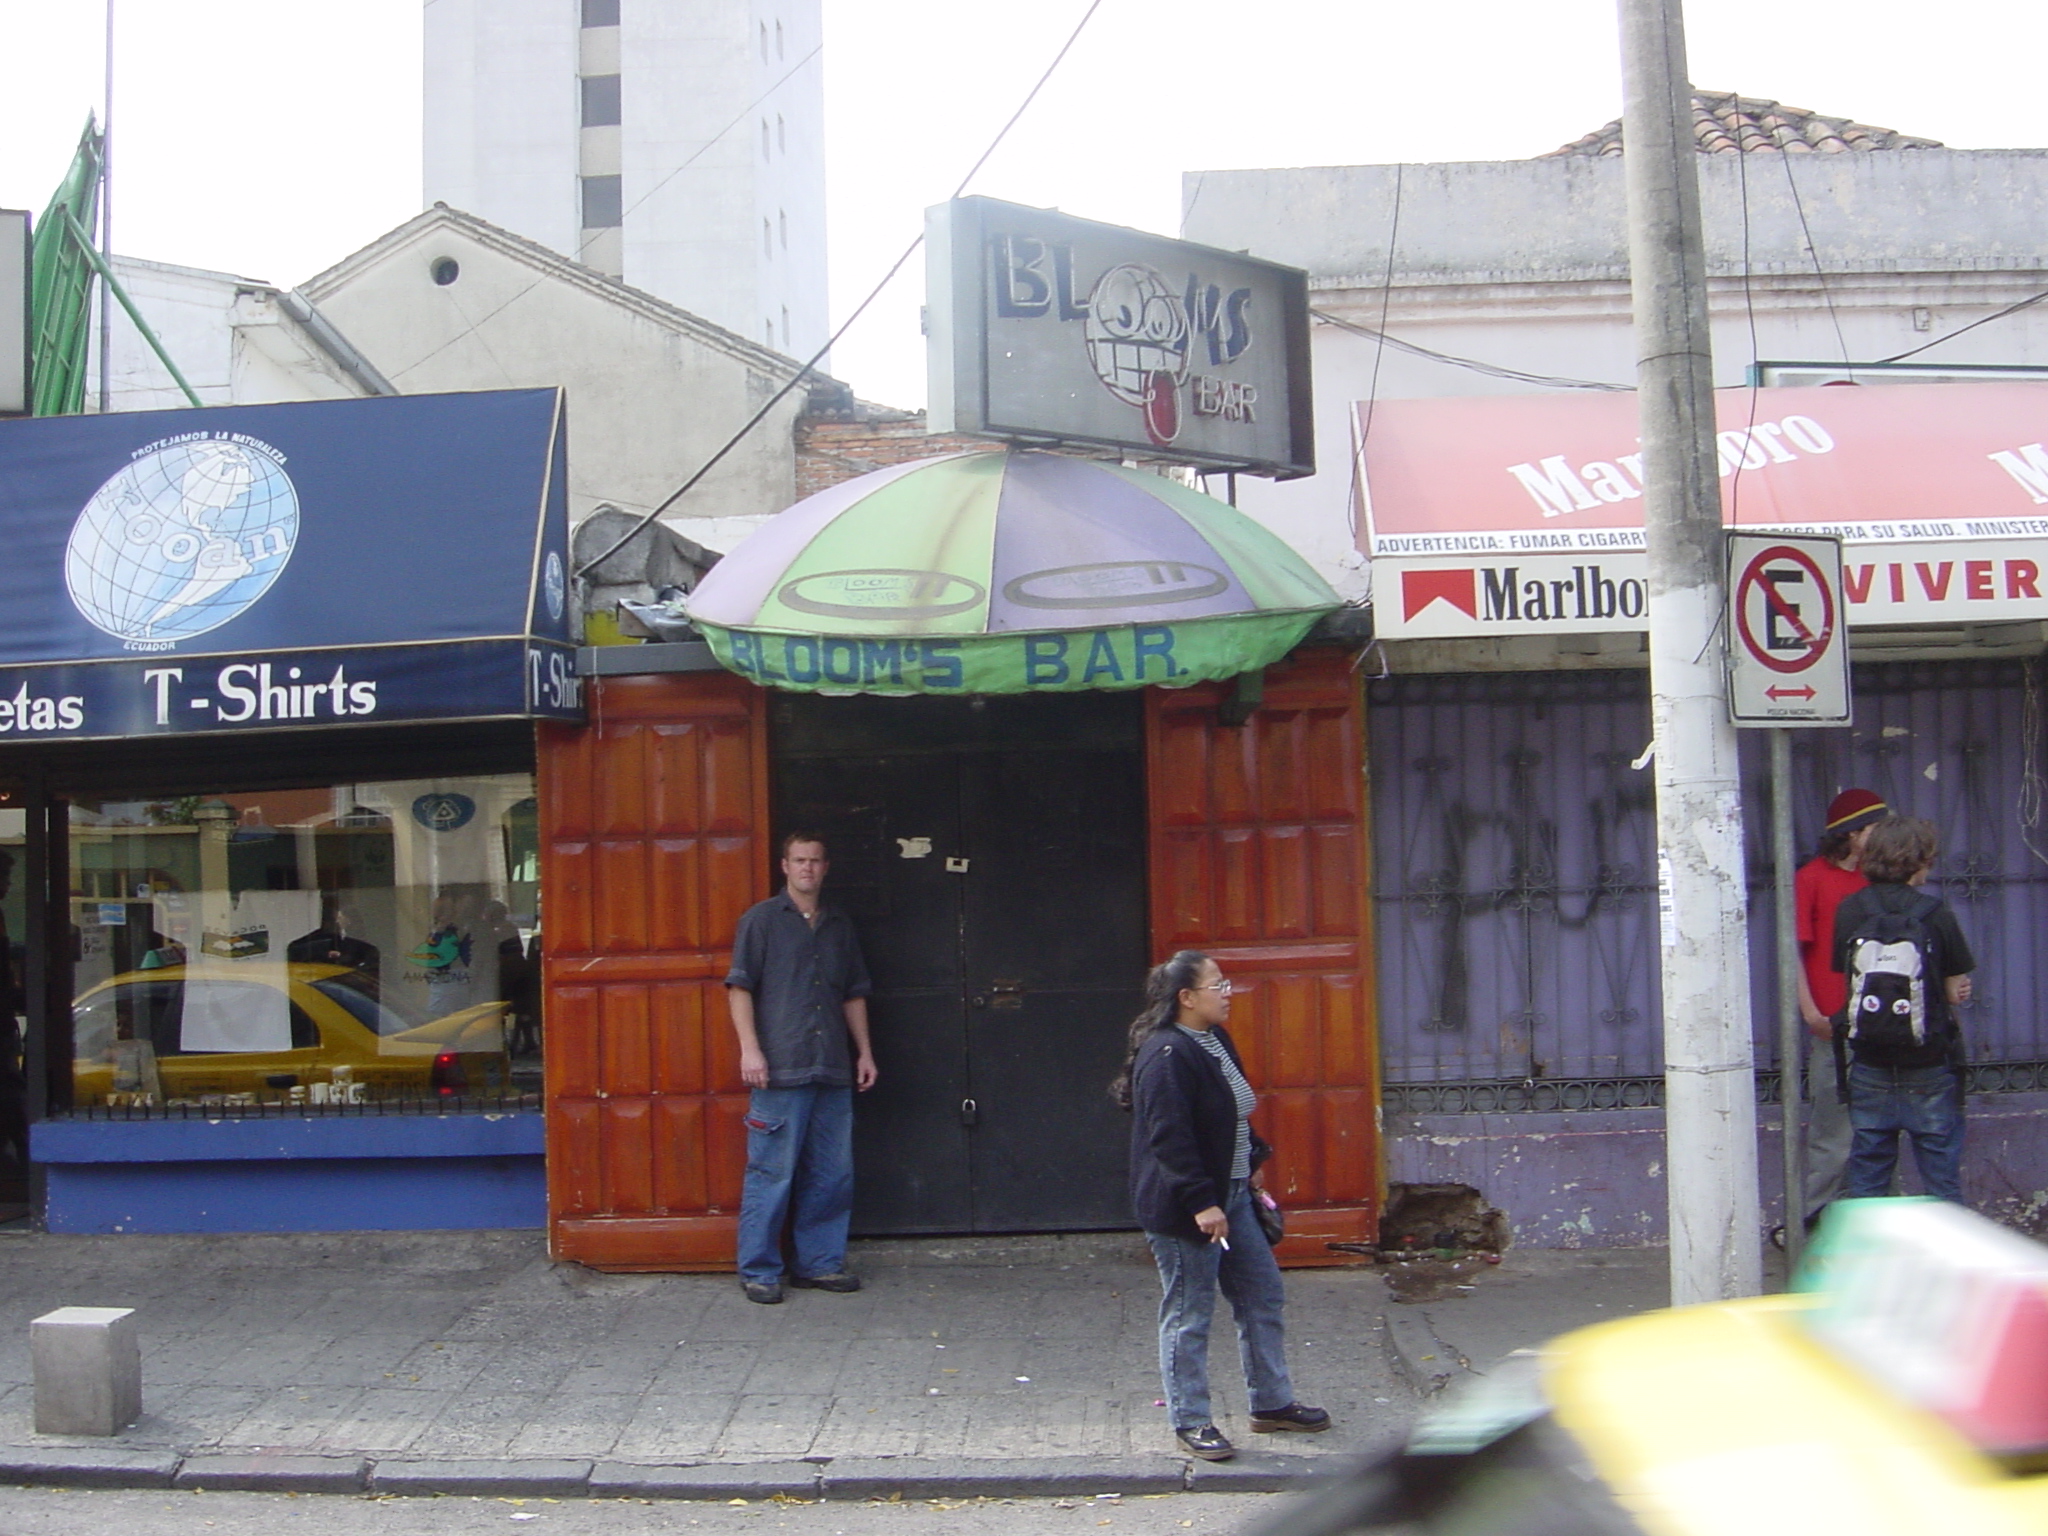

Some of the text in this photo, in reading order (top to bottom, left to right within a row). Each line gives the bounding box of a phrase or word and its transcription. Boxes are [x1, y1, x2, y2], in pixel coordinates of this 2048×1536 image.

[1192, 374, 1257, 424] BAR
[131, 431, 288, 466] PROTEJAMOS LA NATURALEZA
[1377, 530, 1646, 552] ADVERTENCIA: FUMAR CIGARR
[1874, 524, 1896, 538] SU
[1901, 521, 1961, 537] SALUD.
[1765, 569, 1807, 650] E
[123, 641, 176, 652] ECUADOR
[529, 649, 583, 709] T-Shir
